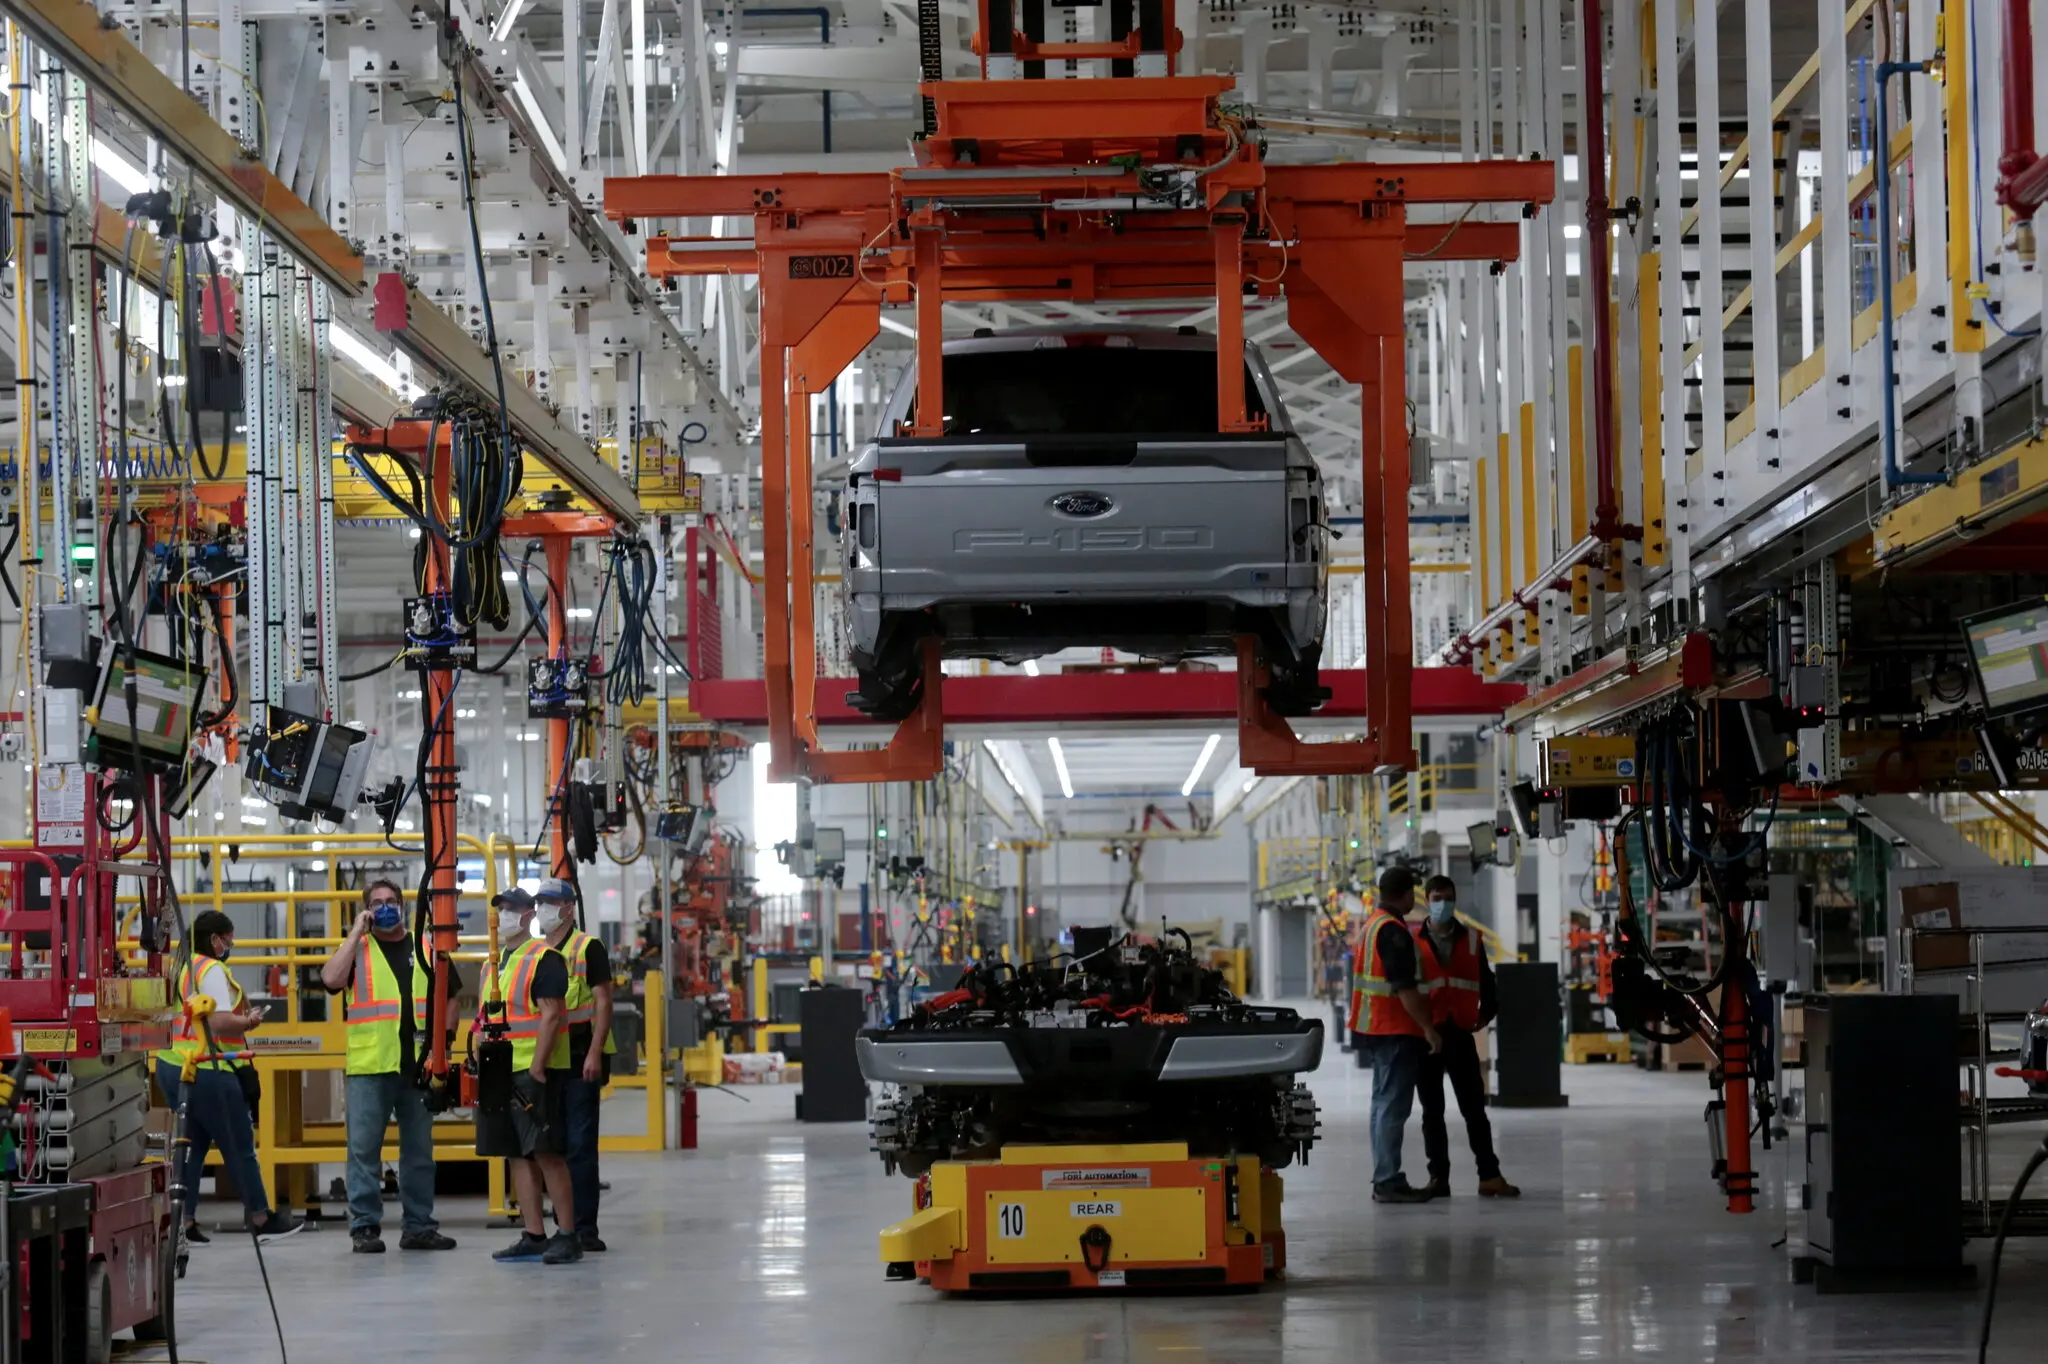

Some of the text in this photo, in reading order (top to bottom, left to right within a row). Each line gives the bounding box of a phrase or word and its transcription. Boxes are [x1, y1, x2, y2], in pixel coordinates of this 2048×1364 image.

[812, 256, 850, 276] 002
[1066, 498, 1099, 512] Ford
[953, 525, 1215, 552] F-150
[1077, 1203, 1114, 1215] REAR
[1001, 1204, 1023, 1236] 10
